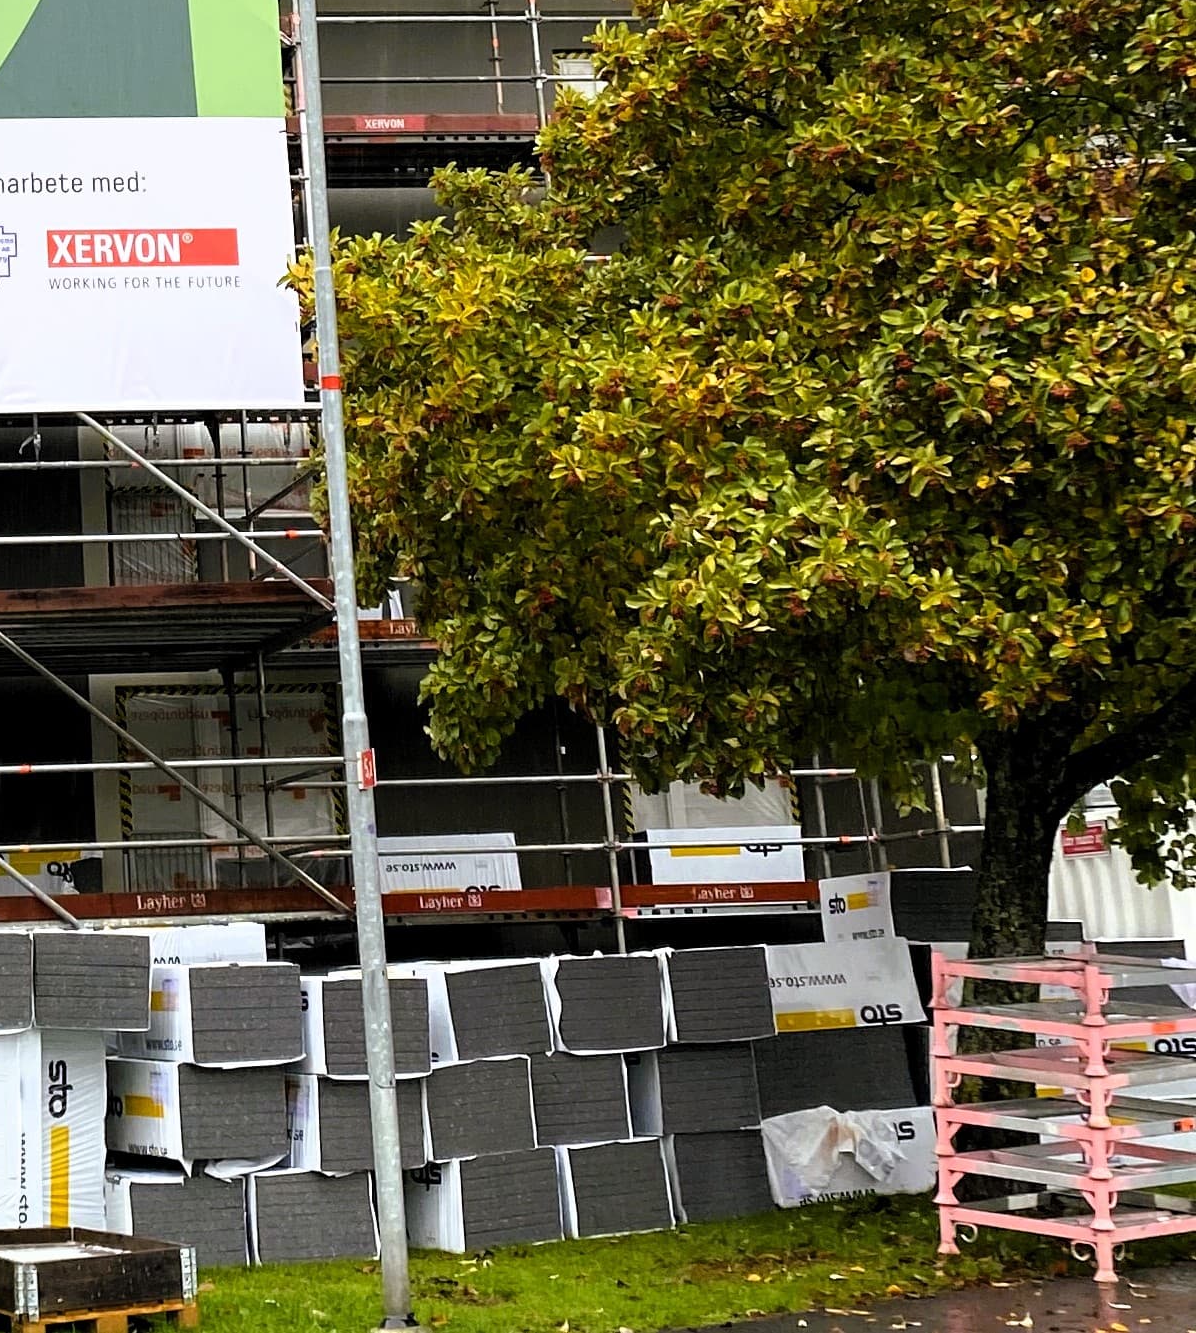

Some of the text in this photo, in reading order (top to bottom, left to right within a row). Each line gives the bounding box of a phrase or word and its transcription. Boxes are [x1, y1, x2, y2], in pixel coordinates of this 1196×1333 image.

[364, 118, 405, 130] XERVON
[92, 171, 148, 193] med:
[51, 233, 181, 264] XERVON
[48, 275, 241, 290] WORKING FOR THE FUTURE
[136, 894, 186, 911] Layher
[418, 894, 464, 910] Layher
[860, 1003, 903, 1026] sto
[49, 1059, 74, 1118] sto
